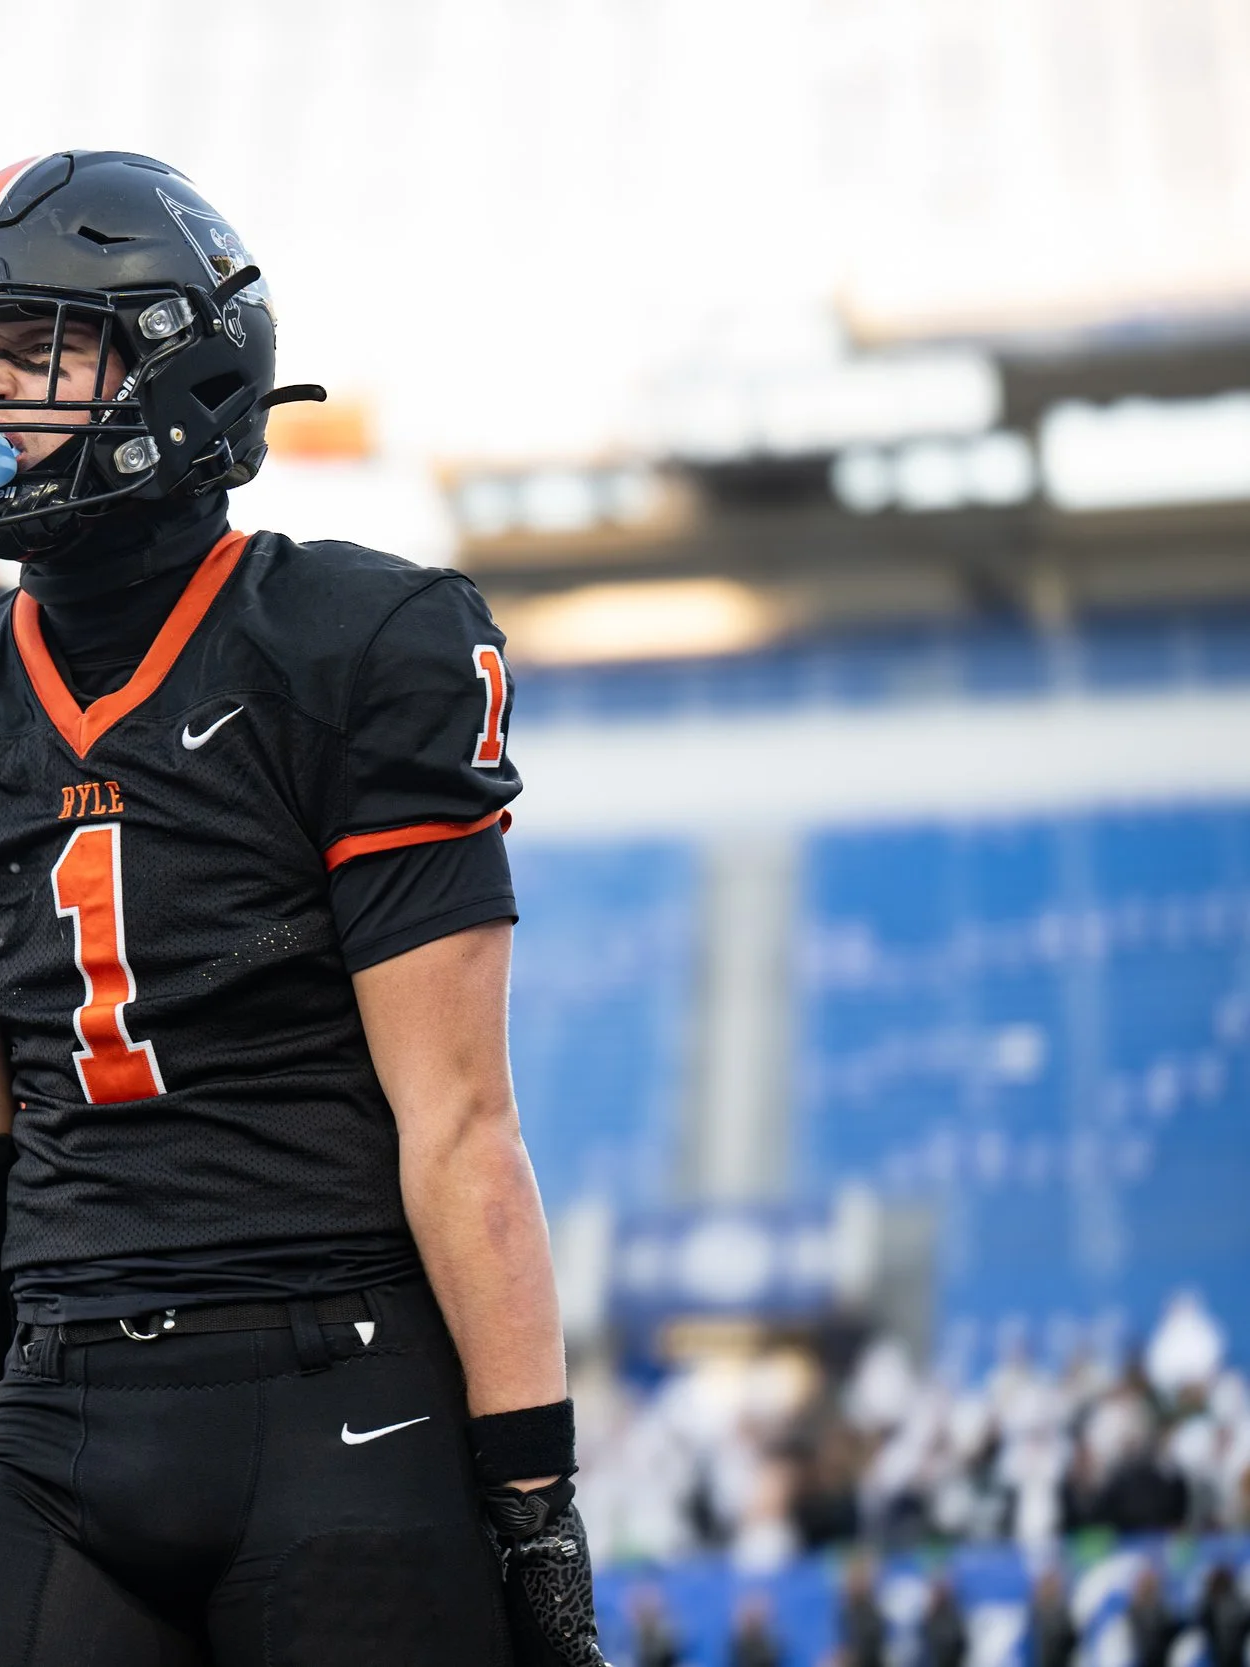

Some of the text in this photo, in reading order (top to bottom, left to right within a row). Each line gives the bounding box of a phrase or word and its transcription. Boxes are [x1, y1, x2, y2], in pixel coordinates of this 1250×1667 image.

[471, 644, 508, 768] 1
[58, 781, 124, 820] RYLE
[51, 822, 168, 1104] 1
